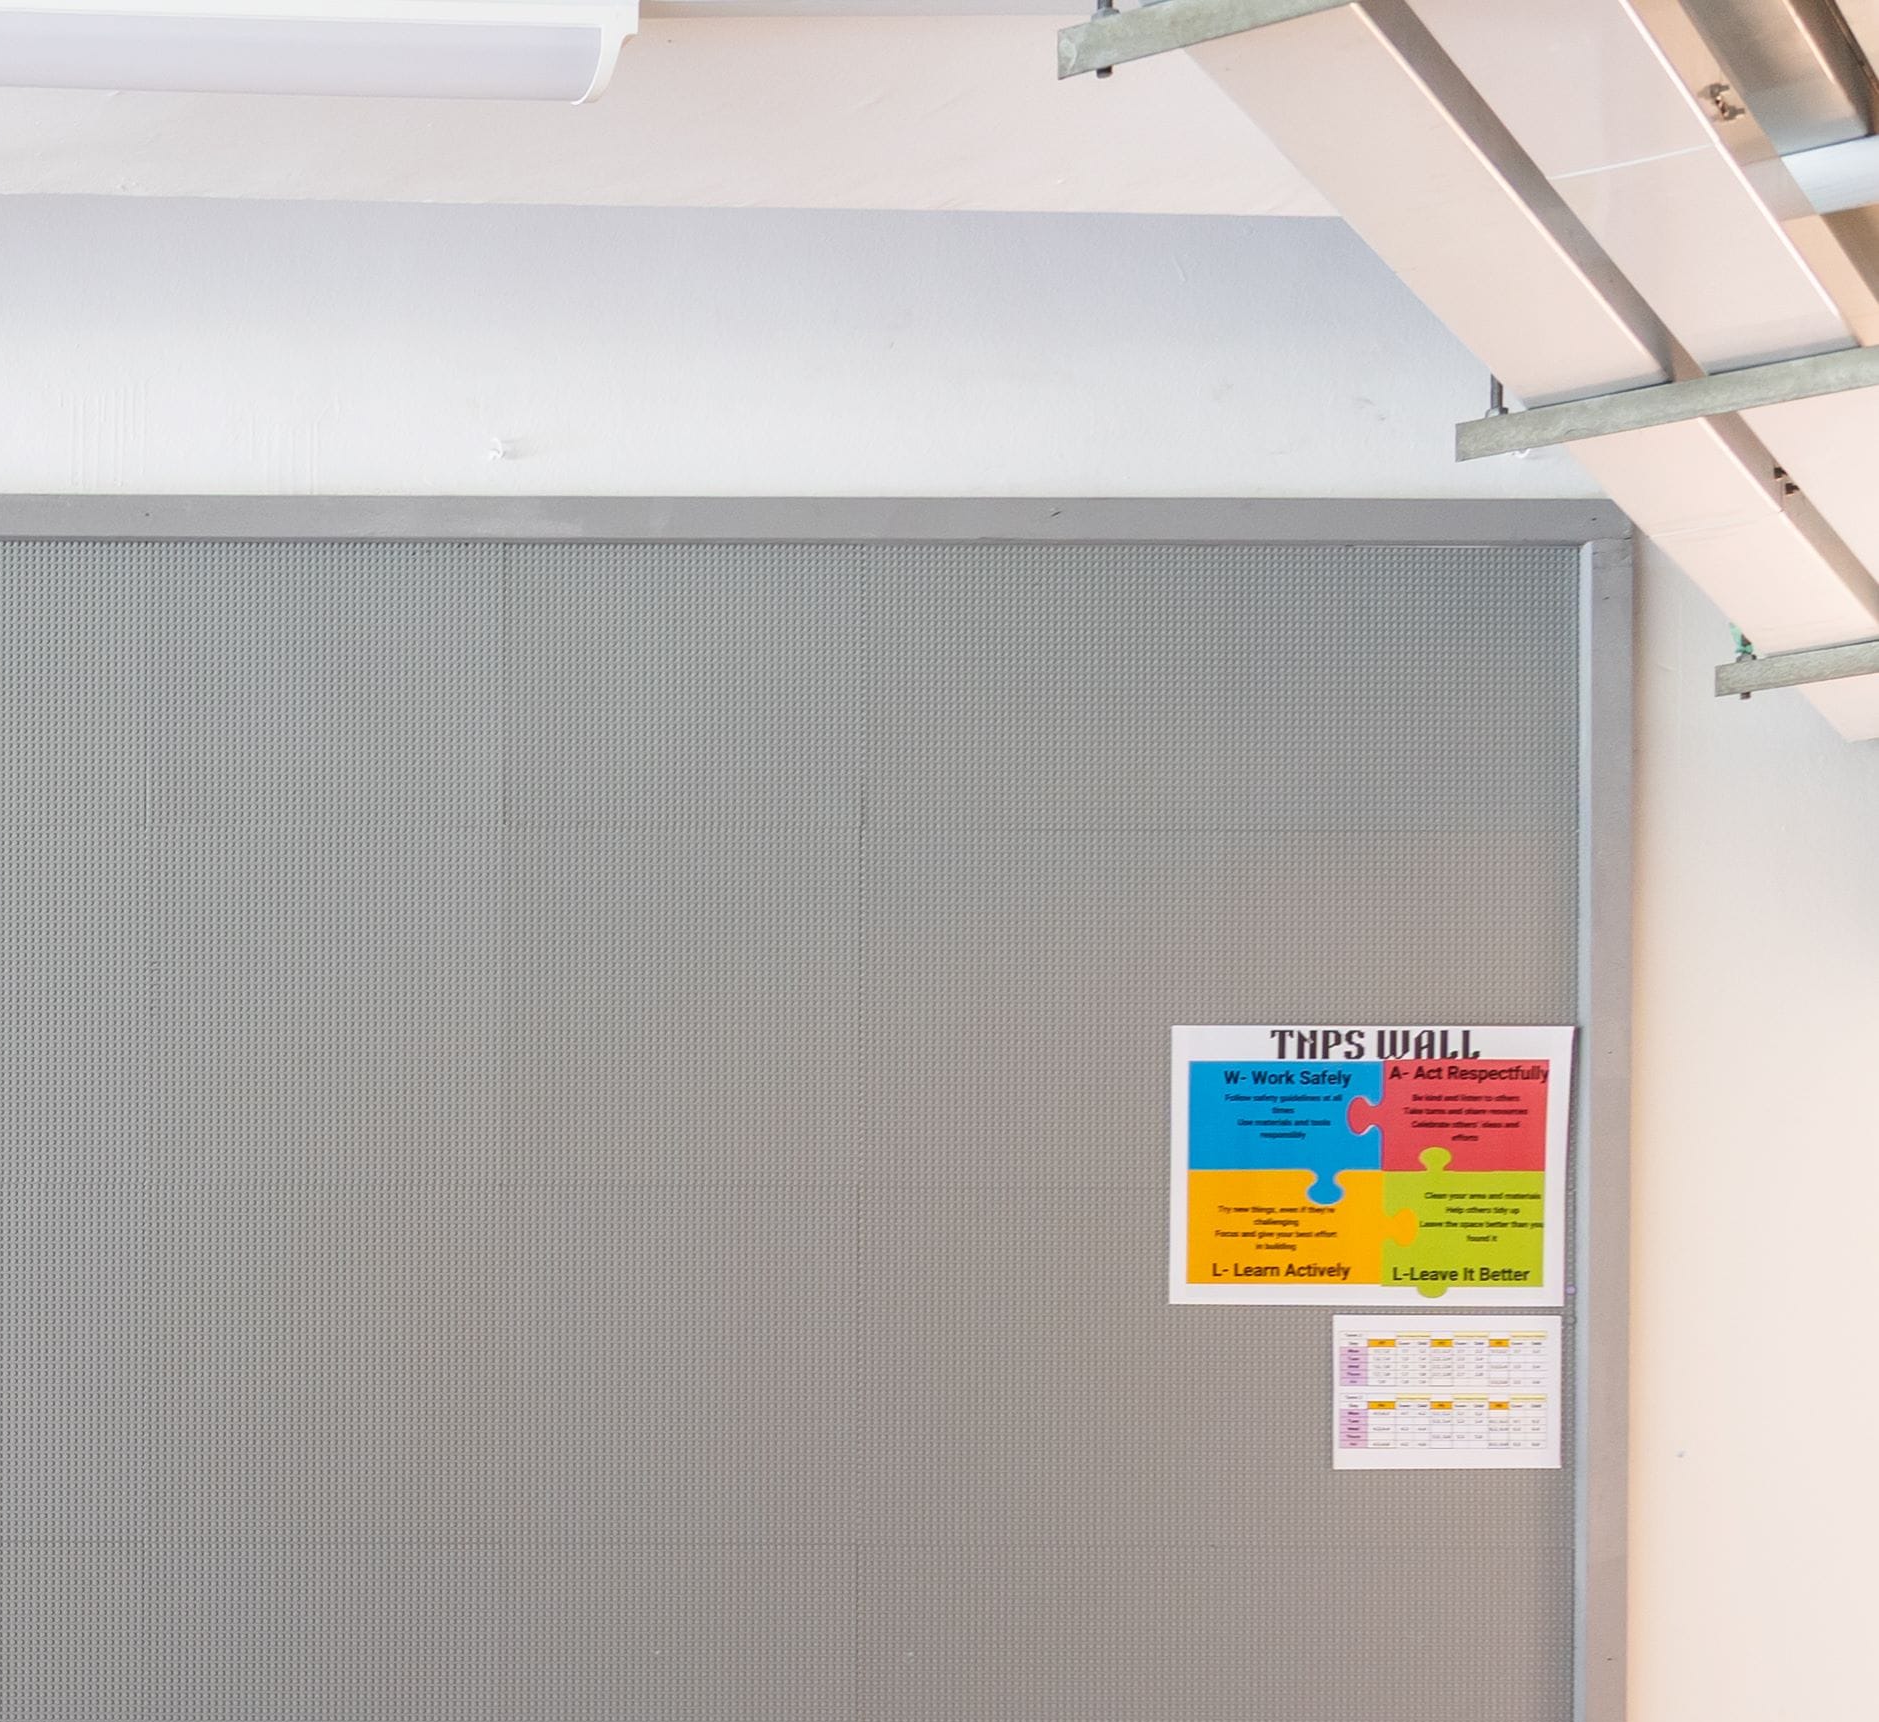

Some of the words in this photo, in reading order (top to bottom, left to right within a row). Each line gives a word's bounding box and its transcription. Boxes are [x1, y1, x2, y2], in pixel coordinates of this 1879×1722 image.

[1270, 1030, 1365, 1060] TNPS
[1377, 1030, 1481, 1060] WALL
[1251, 1070, 1295, 1085] Work
[1299, 1069, 1352, 1088] Safely
[1414, 1065, 1444, 1080] Act
[1447, 1065, 1550, 1084] Respectfully
[1234, 1263, 1280, 1277] Learn
[1284, 1262, 1351, 1280] Actively
[1463, 1267, 1475, 1281] It
[1479, 1267, 1531, 1281] Better
